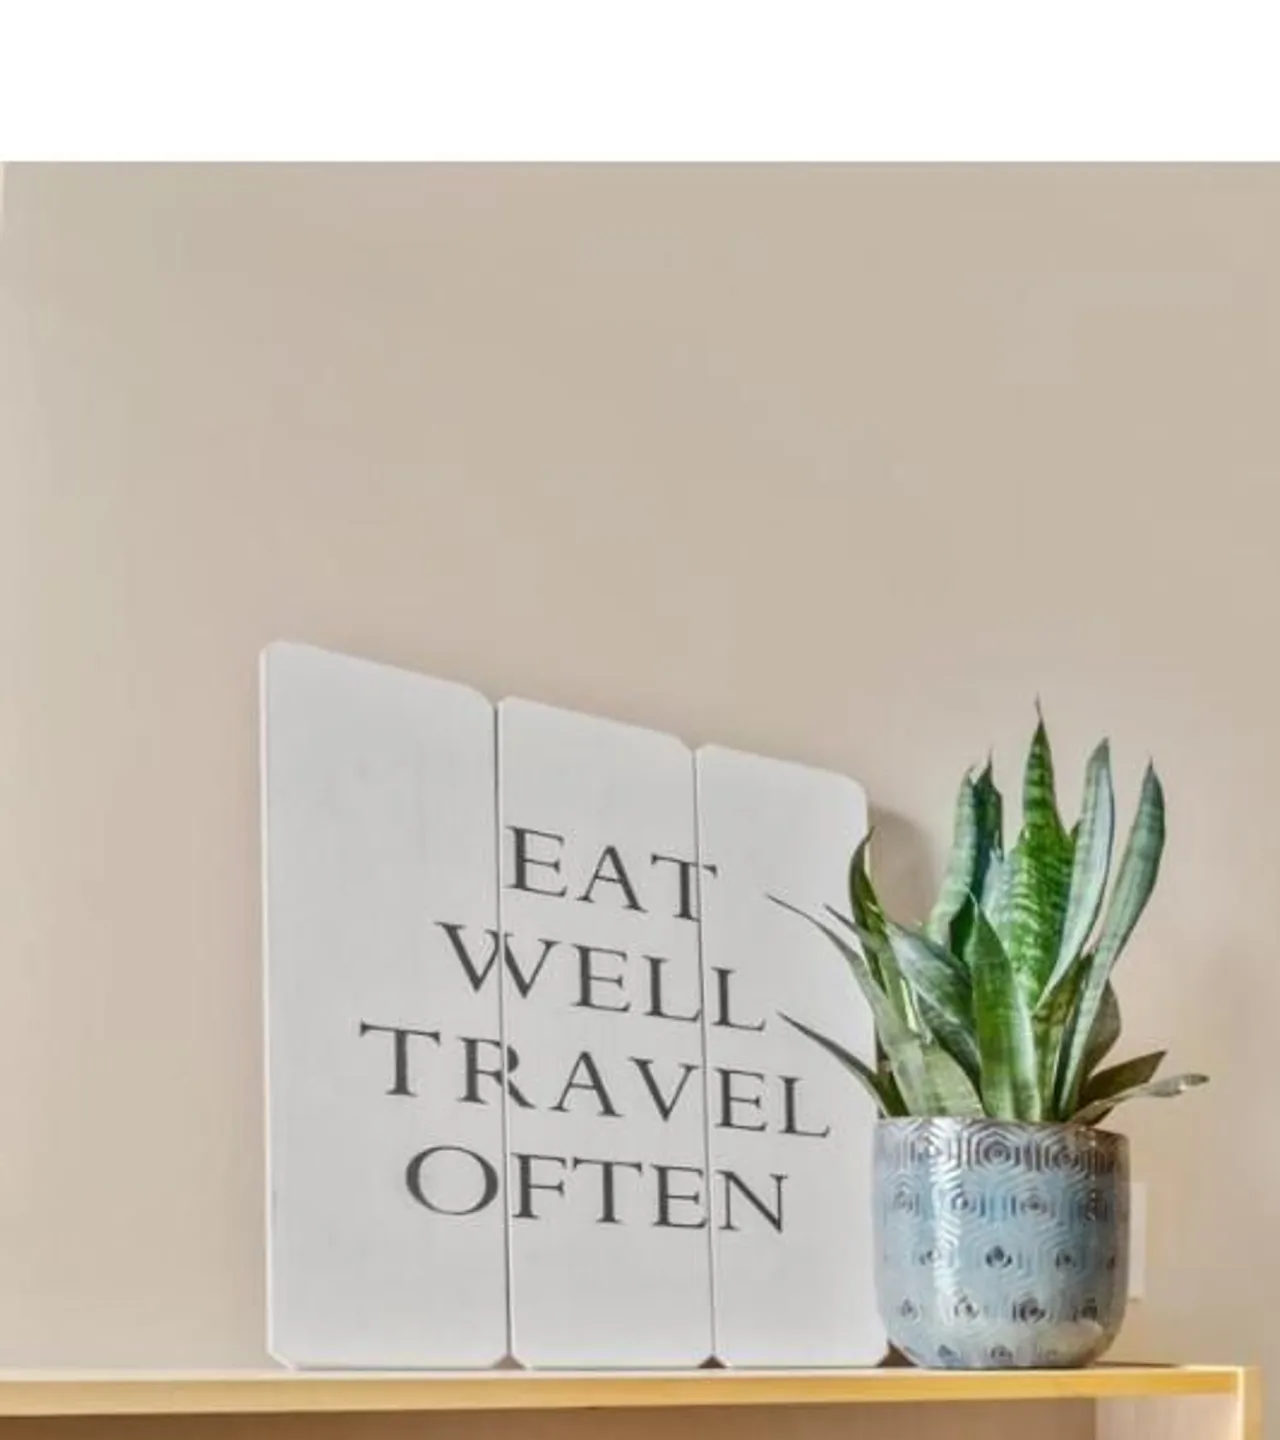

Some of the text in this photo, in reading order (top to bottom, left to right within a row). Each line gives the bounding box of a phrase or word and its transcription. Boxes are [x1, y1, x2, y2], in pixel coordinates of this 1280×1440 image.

[505, 825, 718, 922] EAT
[433, 920, 766, 1033] WELL
[358, 1020, 831, 1139] TRAVEL
[404, 1144, 789, 1234] OFTEN
